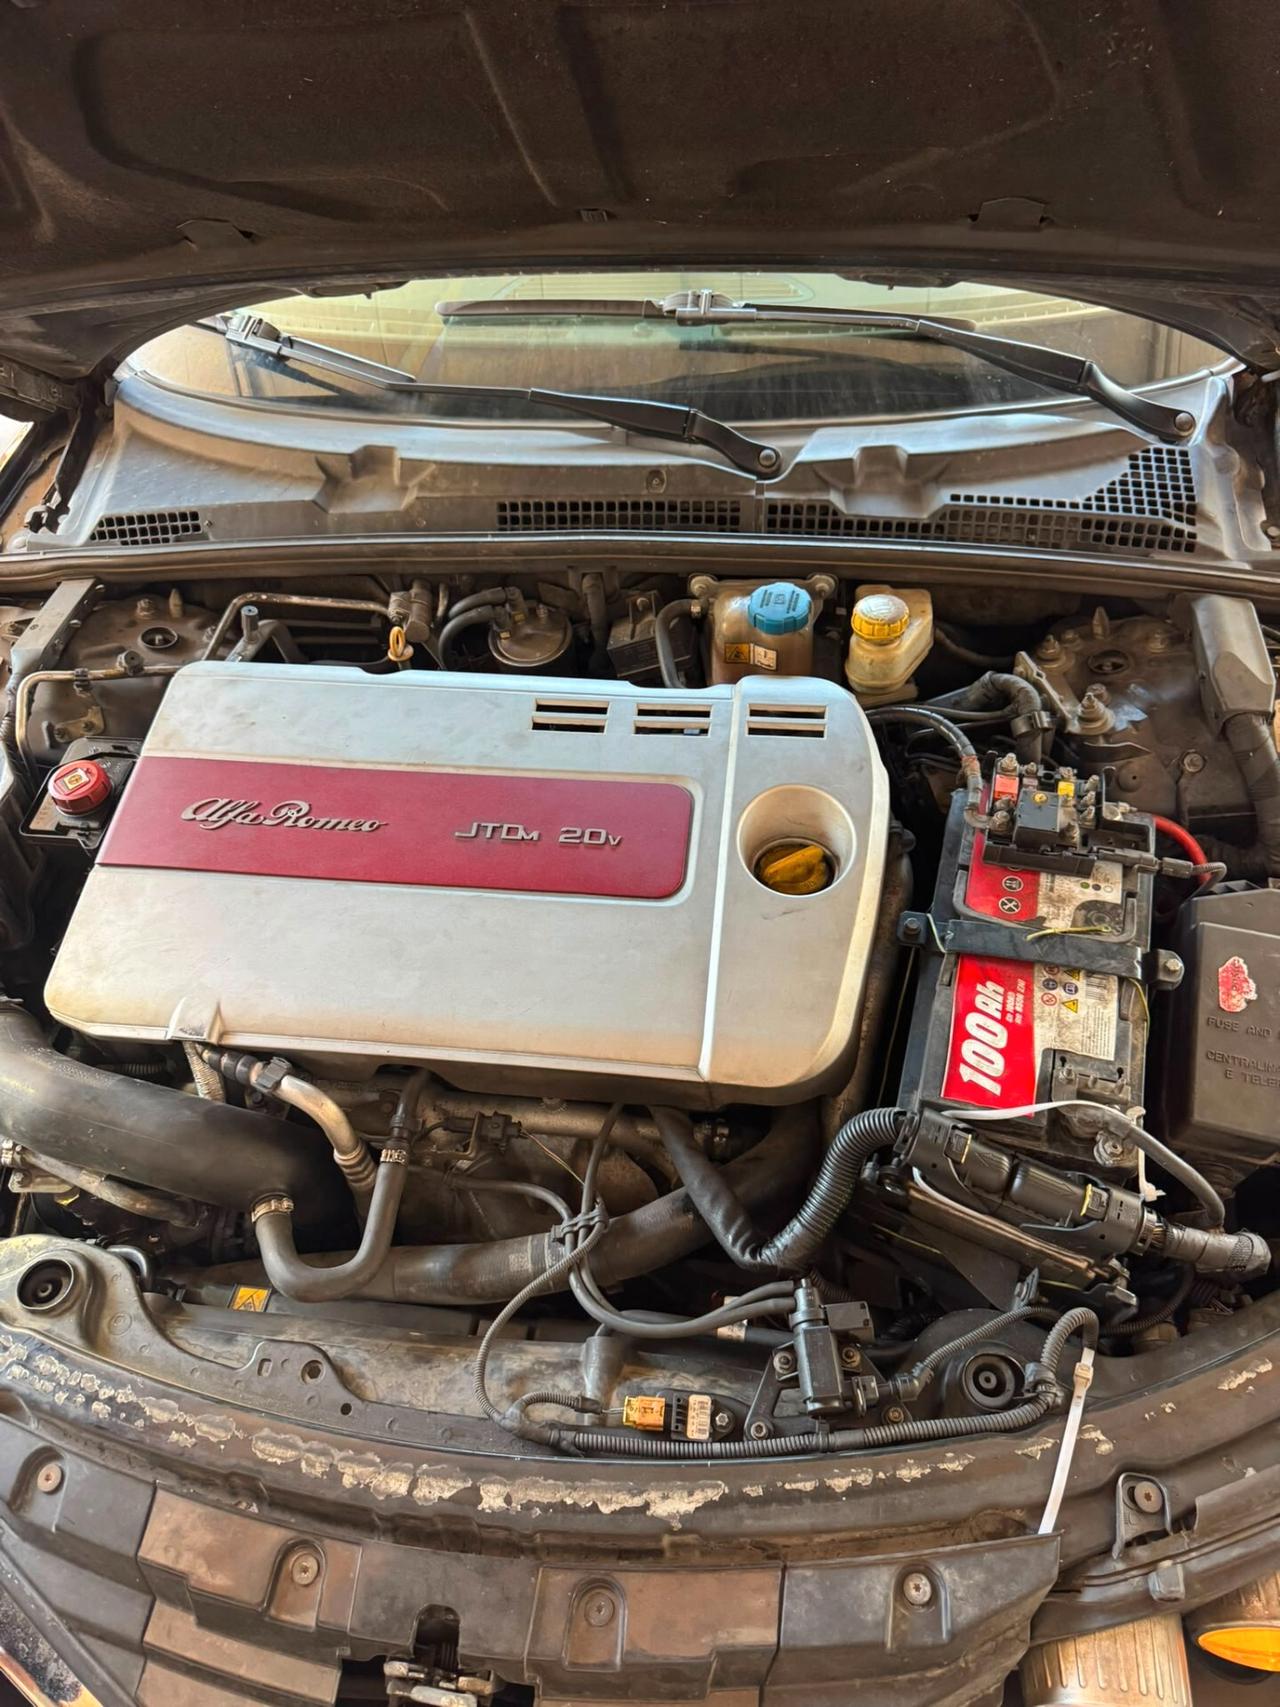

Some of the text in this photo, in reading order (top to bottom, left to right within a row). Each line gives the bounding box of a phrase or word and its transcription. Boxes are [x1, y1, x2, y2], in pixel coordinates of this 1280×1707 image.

[181, 797, 388, 832] Alfa Romeo
[1207, 1016, 1239, 1032] FUSE
[1246, 1024, 1272, 1038] AND
